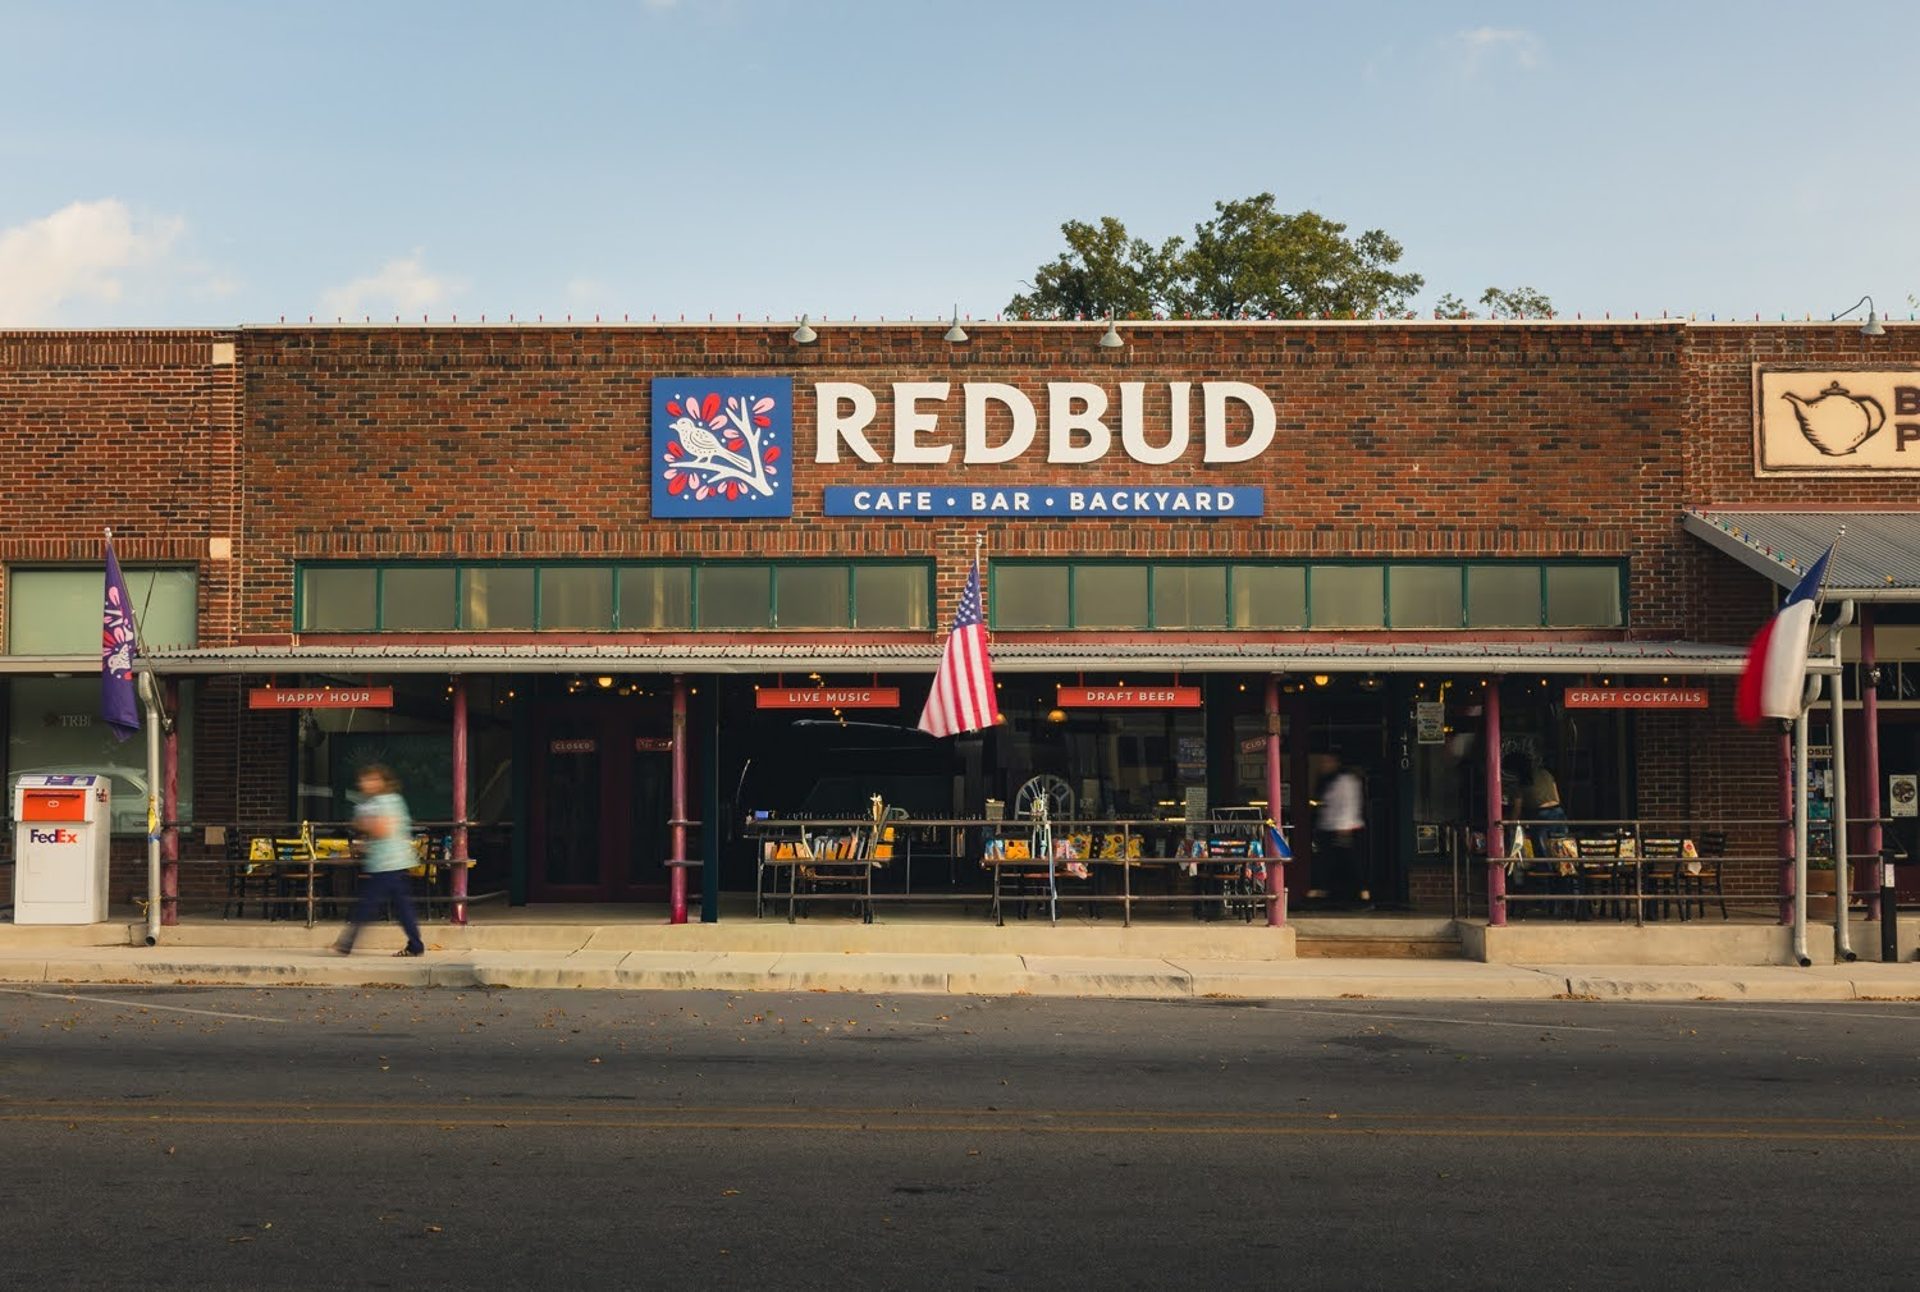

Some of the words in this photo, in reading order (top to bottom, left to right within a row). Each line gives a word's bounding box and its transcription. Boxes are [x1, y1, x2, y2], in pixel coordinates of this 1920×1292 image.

[814, 382, 1277, 464] REDBUD
[853, 491, 932, 511] CAFE
[971, 491, 1030, 511] BAR
[1069, 491, 1236, 511] BACKYARD
[277, 692, 324, 703] HAPPY
[330, 692, 370, 702] HOUR
[789, 692, 820, 702] LIVE
[826, 692, 870, 702] MUSIC
[1087, 691, 1133, 701] DRAFT
[1139, 691, 1175, 701] BEER
[1571, 692, 1617, 702] CRAFT
[1623, 692, 1701, 702] COCKTAILS
[1245, 738, 1267, 749] CLOS
[30, 829, 77, 843] FedEx
